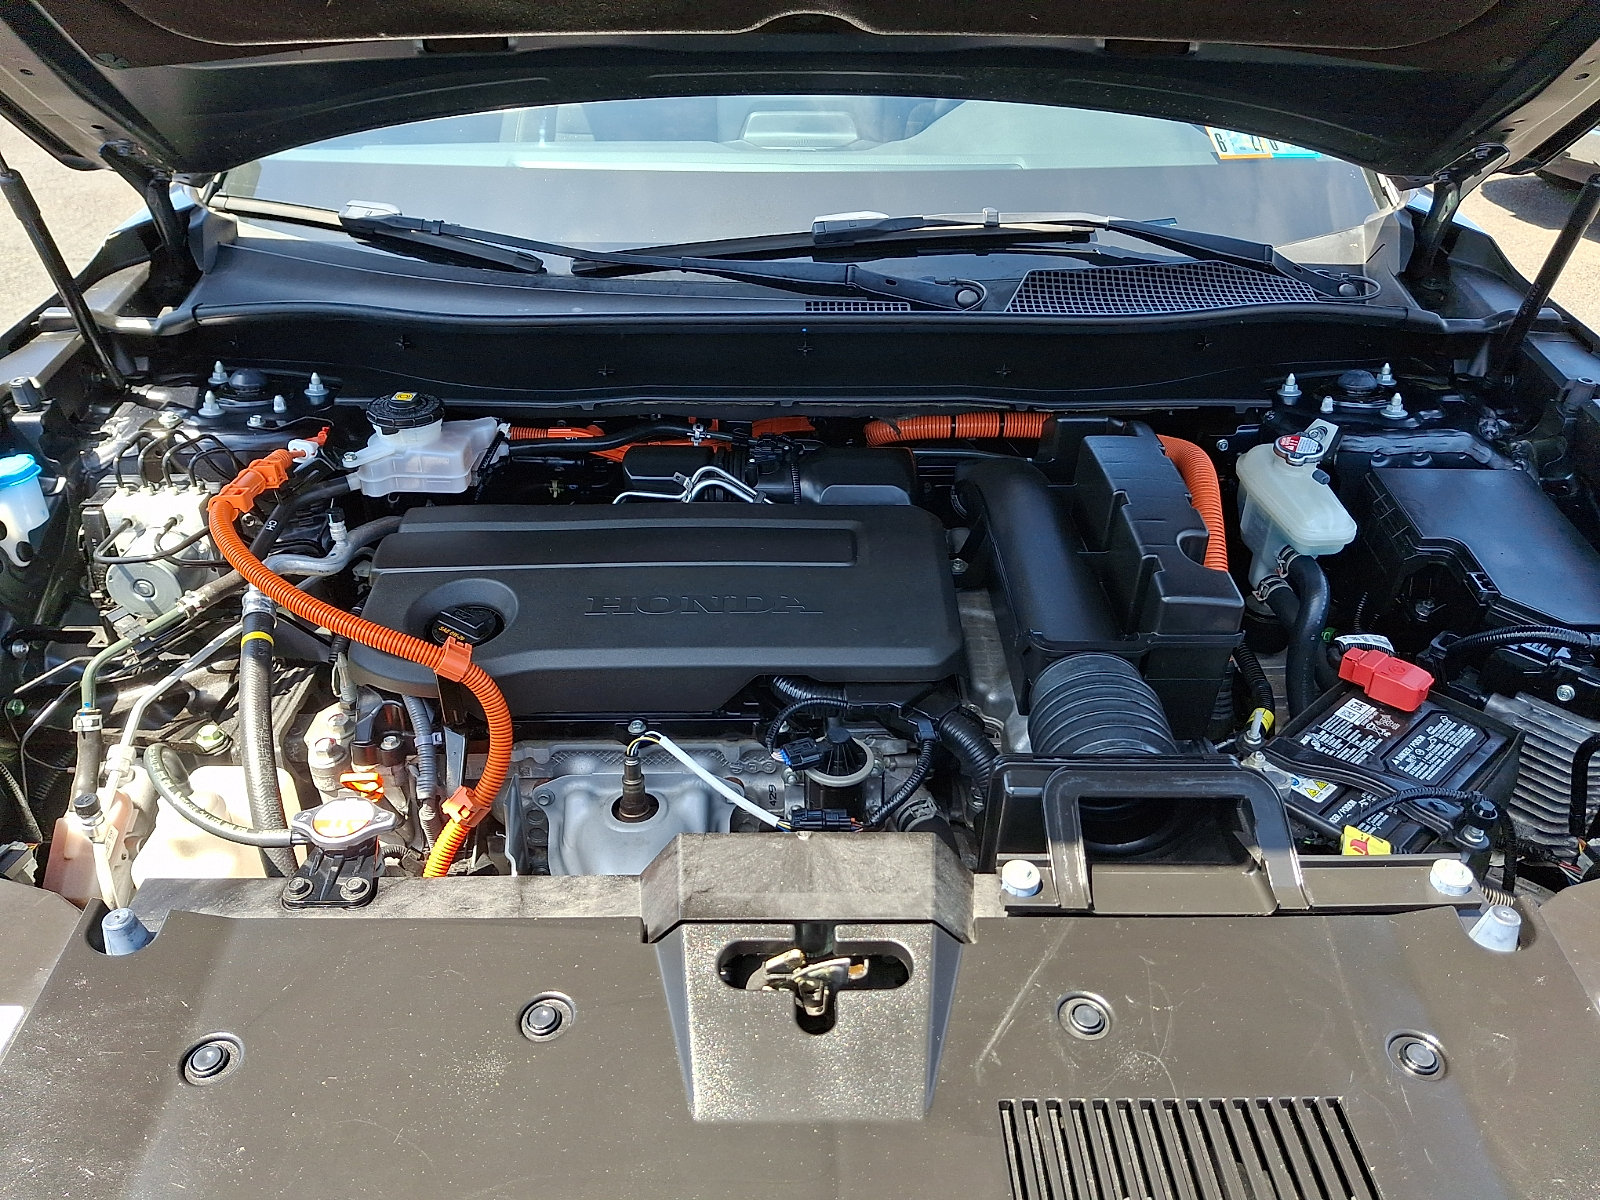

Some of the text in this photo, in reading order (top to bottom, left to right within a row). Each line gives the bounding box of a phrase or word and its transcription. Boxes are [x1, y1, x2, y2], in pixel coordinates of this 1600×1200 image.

[266, 520, 278, 531] CH
[584, 595, 824, 616] HONDA
[439, 626, 451, 634] SAE
[768, 784, 777, 807] 429
